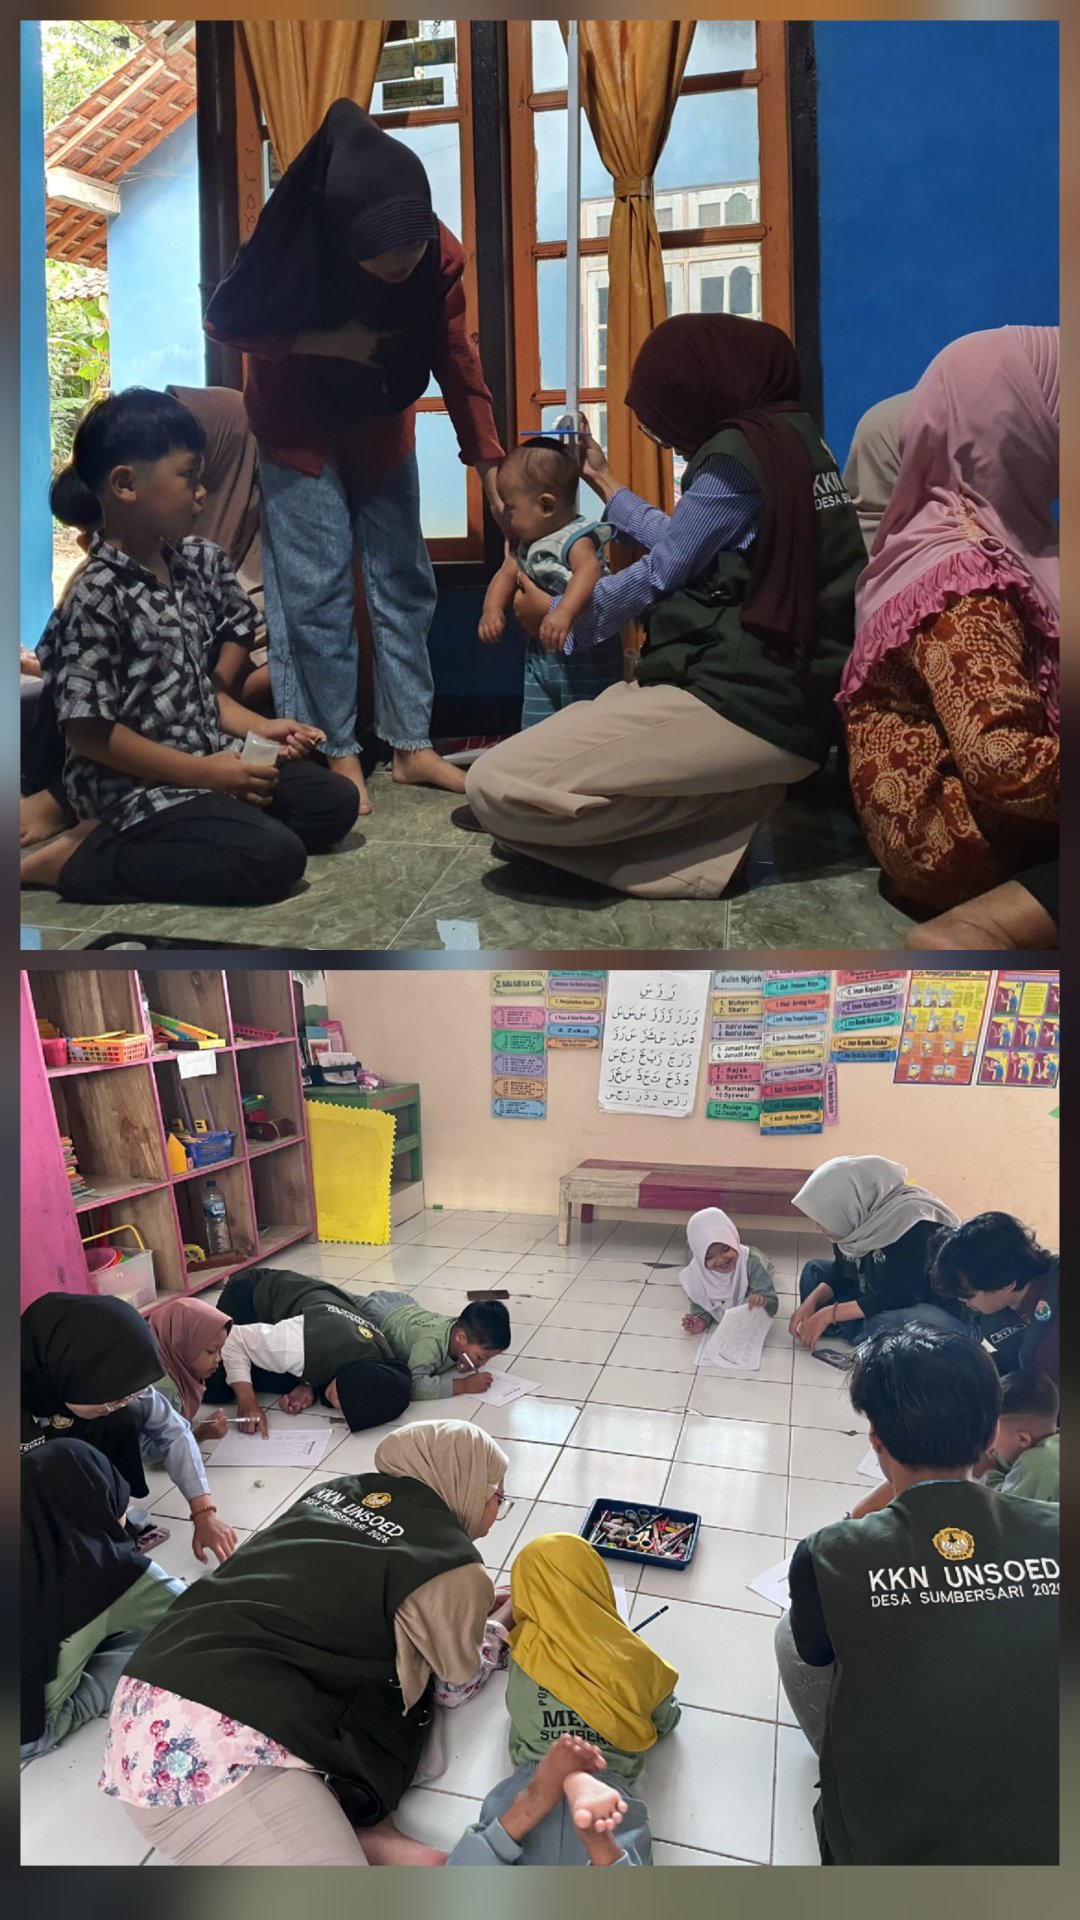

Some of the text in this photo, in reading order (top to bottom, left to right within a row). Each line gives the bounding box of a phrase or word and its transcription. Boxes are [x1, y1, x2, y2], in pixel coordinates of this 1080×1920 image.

[814, 494, 842, 511] DESA
[312, 1488, 404, 1537] KKN UNSOED
[320, 1503, 369, 1531] SUMBERSARI
[868, 1557, 1060, 1592] KKN UNSOED
[870, 1592, 912, 1608] DESA
[919, 1584, 1024, 1605] SUMBERSARI
[542, 1710, 590, 1728] ME
